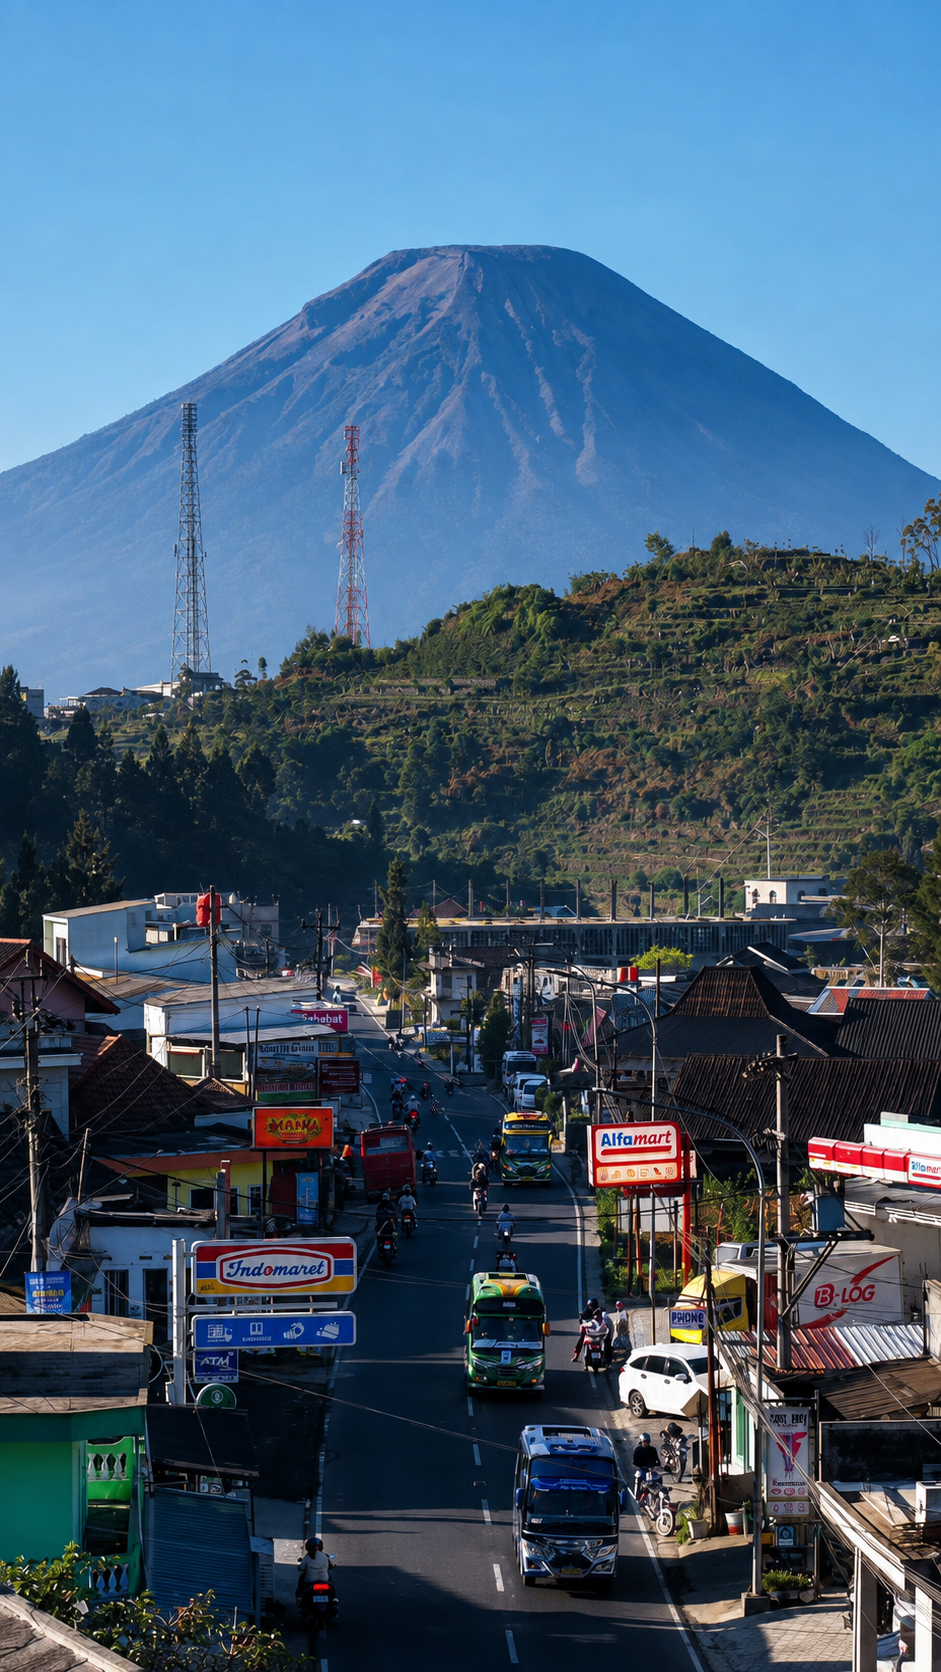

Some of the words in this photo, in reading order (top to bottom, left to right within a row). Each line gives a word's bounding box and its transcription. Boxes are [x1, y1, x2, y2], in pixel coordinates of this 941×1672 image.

[601, 1130, 671, 1147] Alfamart
[226, 1260, 325, 1277] Indomaret
[815, 1284, 875, 1307] B-LOG
[200, 1355, 229, 1366] ATM
